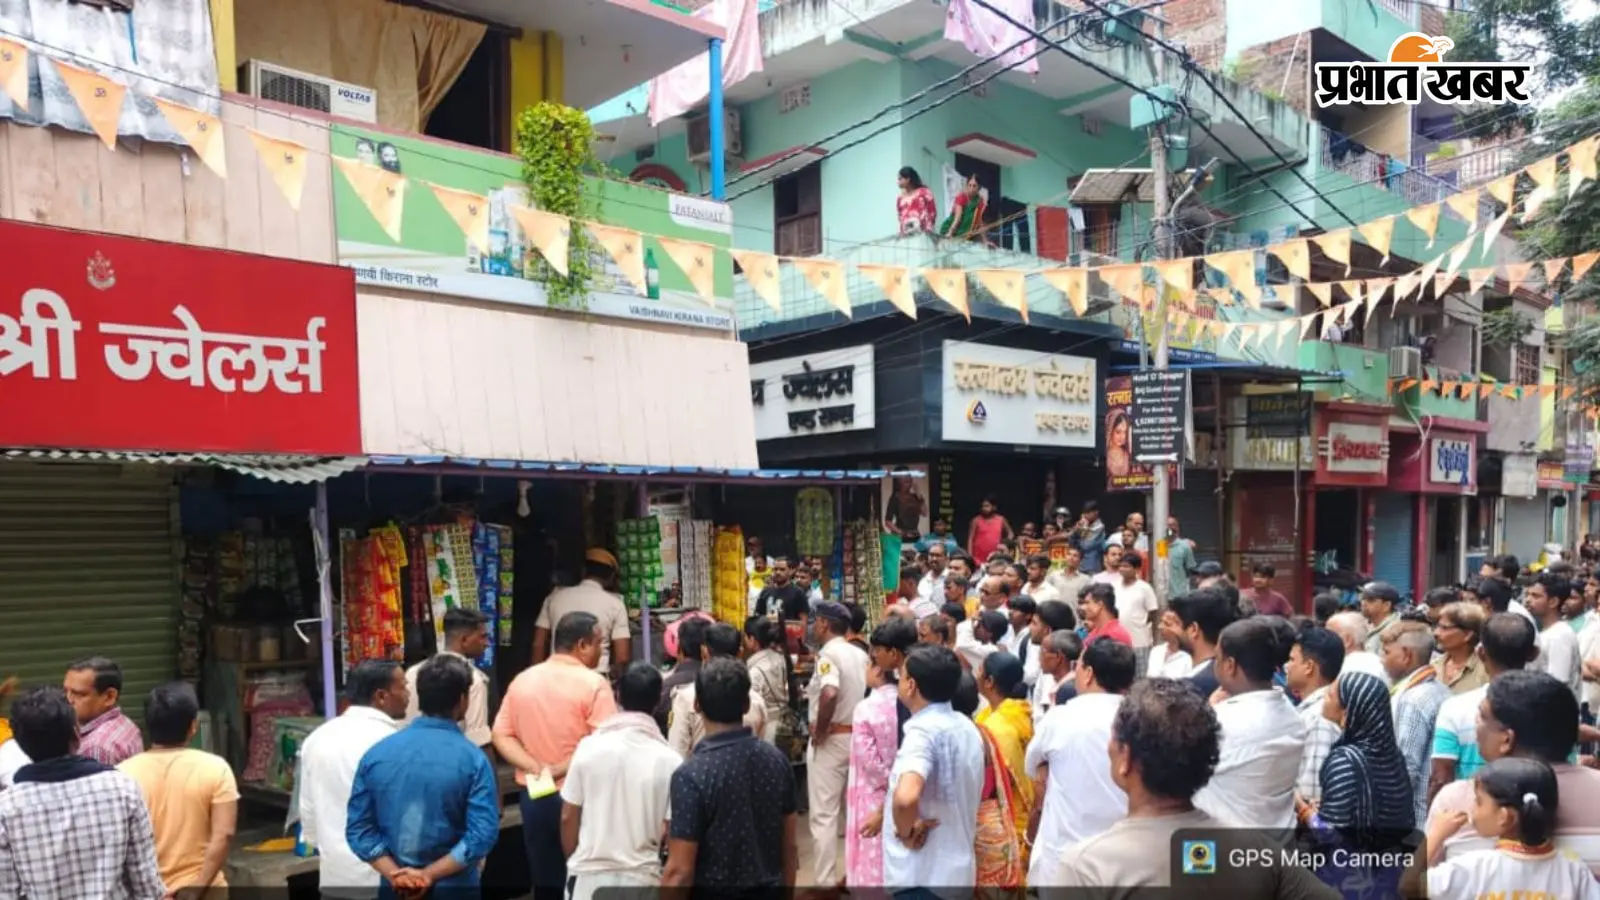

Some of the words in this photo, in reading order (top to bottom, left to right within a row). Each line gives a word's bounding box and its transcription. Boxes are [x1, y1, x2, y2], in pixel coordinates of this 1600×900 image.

[380, 267, 413, 284] किराना
[415, 273, 439, 288] स्टोर
[0, 288, 82, 380] श्री
[99, 304, 326, 393] ज्वेलर्स
